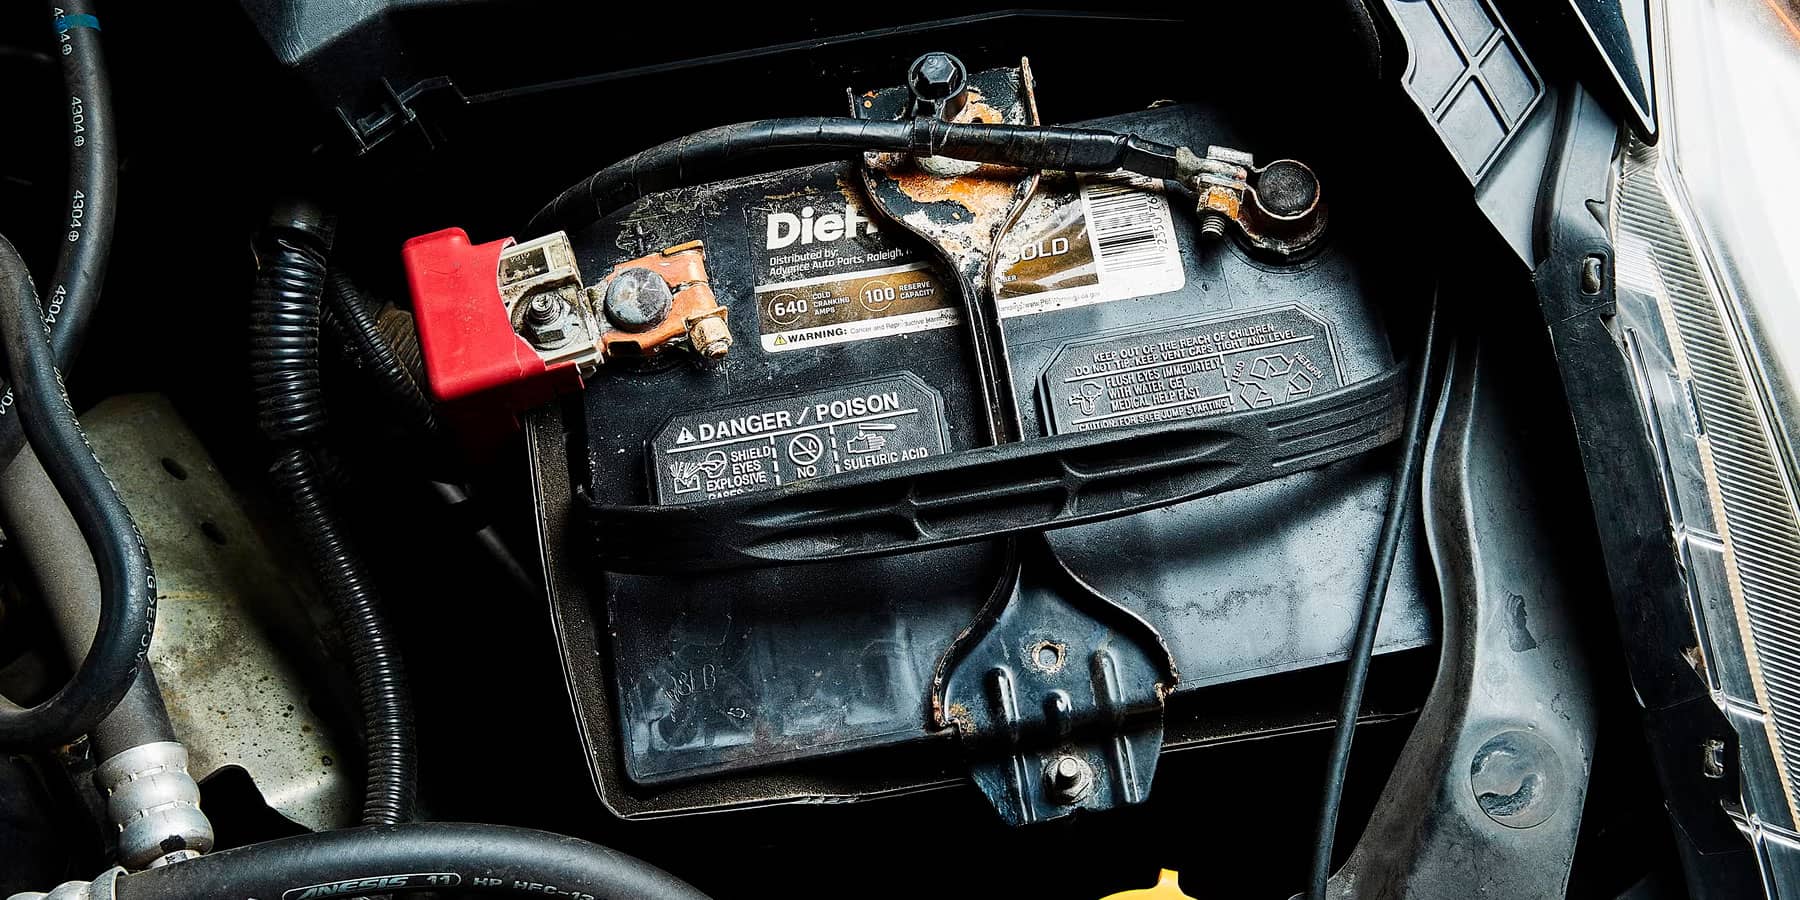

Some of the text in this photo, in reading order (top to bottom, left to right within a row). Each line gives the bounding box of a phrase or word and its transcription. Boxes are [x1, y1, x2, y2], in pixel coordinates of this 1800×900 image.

[54, 7, 71, 42] 44
[71, 96, 84, 133] 4304
[70, 190, 84, 228] 4304
[767, 206, 878, 250] DieH
[769, 248, 839, 266] Distributed by:
[769, 261, 810, 278] Advance
[812, 258, 835, 270] Auto
[837, 256, 864, 266] Parts,
[867, 247, 904, 262] Raleigh,
[812, 291, 831, 300] COLD
[865, 287, 935, 304] 100 CAPACITY
[899, 281, 930, 292] RESERVE
[45, 285, 66, 323] 4304
[774, 296, 850, 316] 640 CRANKING
[814, 306, 835, 316] AMPS
[787, 328, 848, 343] WARNING:
[1094, 324, 1275, 363] KEEP OUT OF THE REACH OF CHILDREN
[1075, 365, 1089, 376] DO
[1092, 362, 1112, 374] NOT
[1135, 354, 1159, 366] KEEP
[1162, 349, 1186, 361] VENT
[1189, 344, 1214, 357] CAPS
[1216, 340, 1243, 353] TIGHT
[1247, 335, 1266, 347] AND
[1268, 330, 1297, 342] LEVEL
[1105, 358, 1220, 388] FLUSH EYES IMMEDIATELY
[1231, 360, 1246, 383] LEAD
[1294, 351, 1324, 379] RETURN
[1108, 384, 1133, 400] WITH
[1168, 378, 1188, 390] GET
[1110, 386, 1201, 412] MEDICAL HELP FAST
[699, 410, 792, 441] DANGER
[815, 392, 899, 421] POISON
[1119, 415, 1137, 426] FOR
[1139, 412, 1160, 424] SAFE
[1161, 407, 1186, 419] JUMP
[1186, 399, 1228, 415] STARTING
[730, 446, 771, 463] SHIELD
[843, 447, 928, 471] SULFURIC ACID
[732, 460, 761, 475] EYES
[796, 465, 817, 479] NO
[706, 471, 767, 492] EXPLOSIVE
[473, 877, 503, 886] HP
